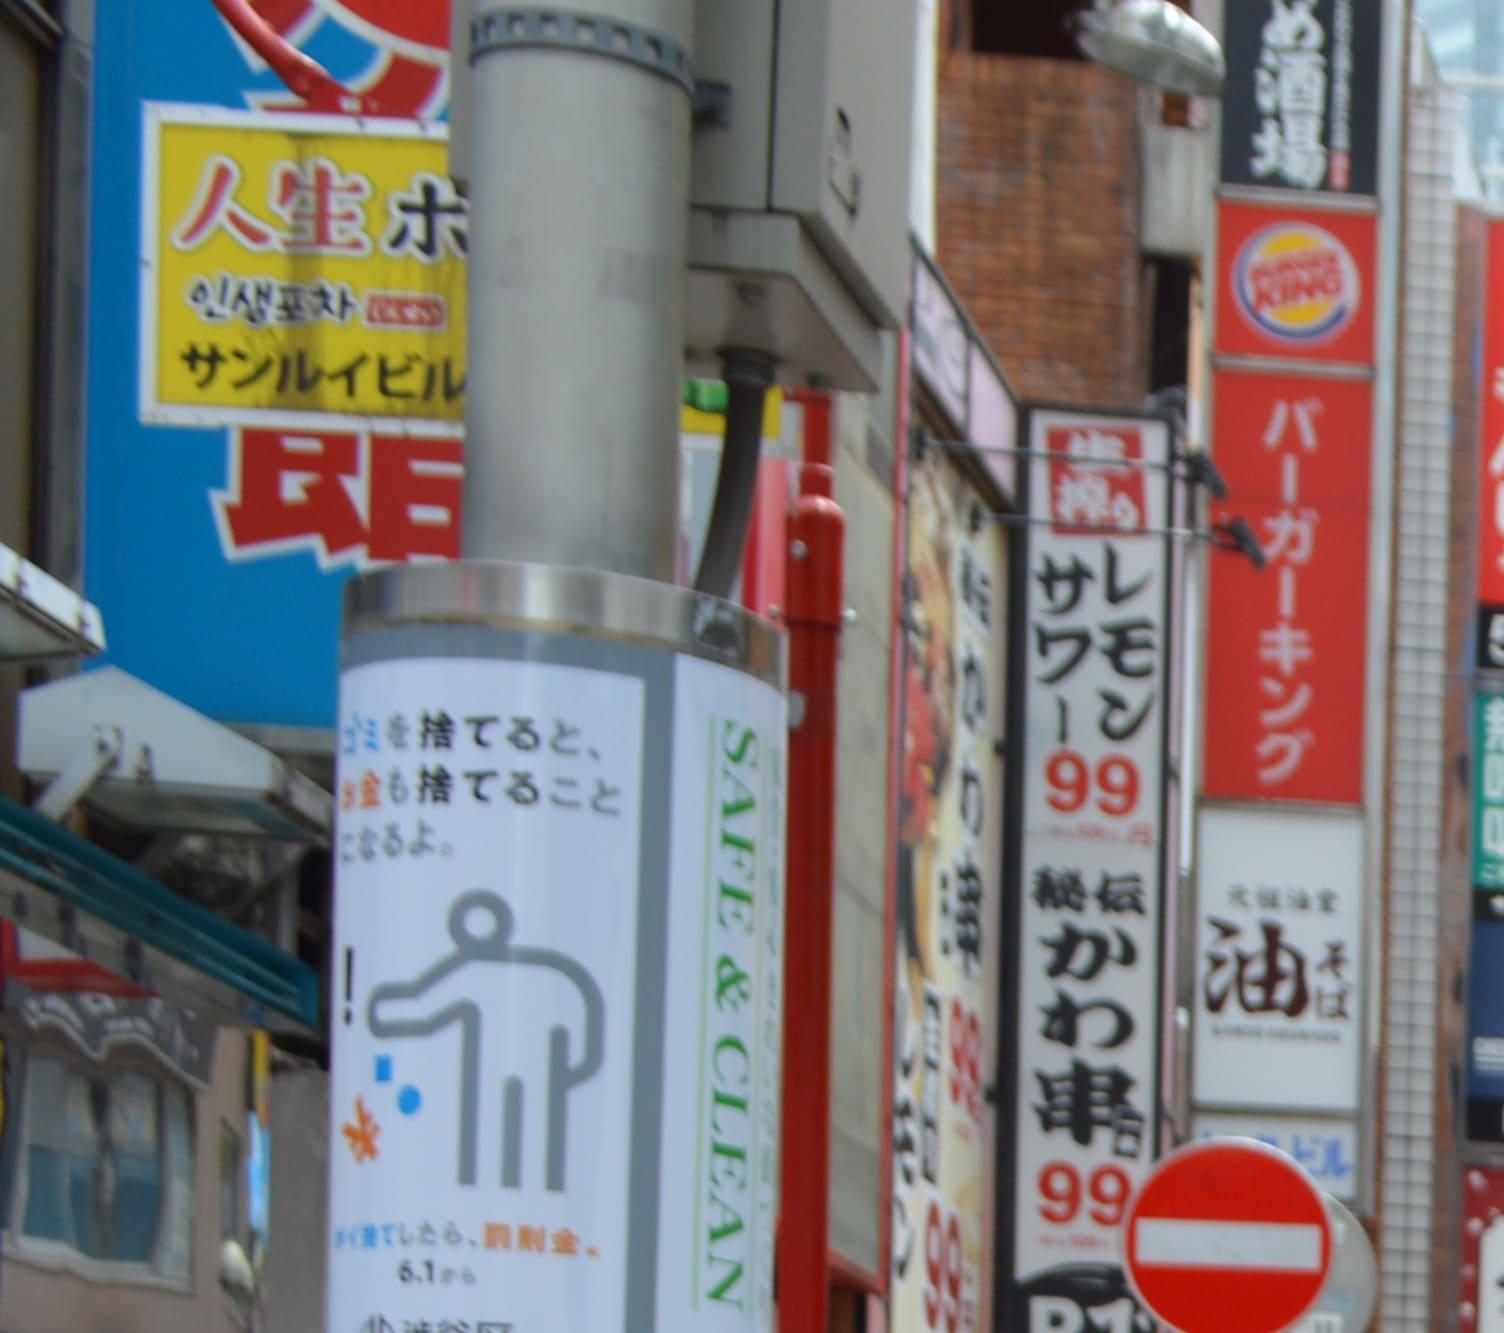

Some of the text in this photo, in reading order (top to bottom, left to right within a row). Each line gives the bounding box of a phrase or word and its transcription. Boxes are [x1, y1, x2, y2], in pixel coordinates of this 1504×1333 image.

[181, 343, 467, 402] サンルイビル
[1253, 270, 1345, 311] KING
[1033, 550, 1096, 745] サワー
[1098, 538, 1157, 743] レモン
[1256, 397, 1323, 785] バーガーキング
[1046, 750, 1140, 817] 99
[707, 718, 757, 1313] SAFE & CLEAN
[1033, 922, 1137, 1146] かわ串
[1206, 915, 1309, 1019] 油
